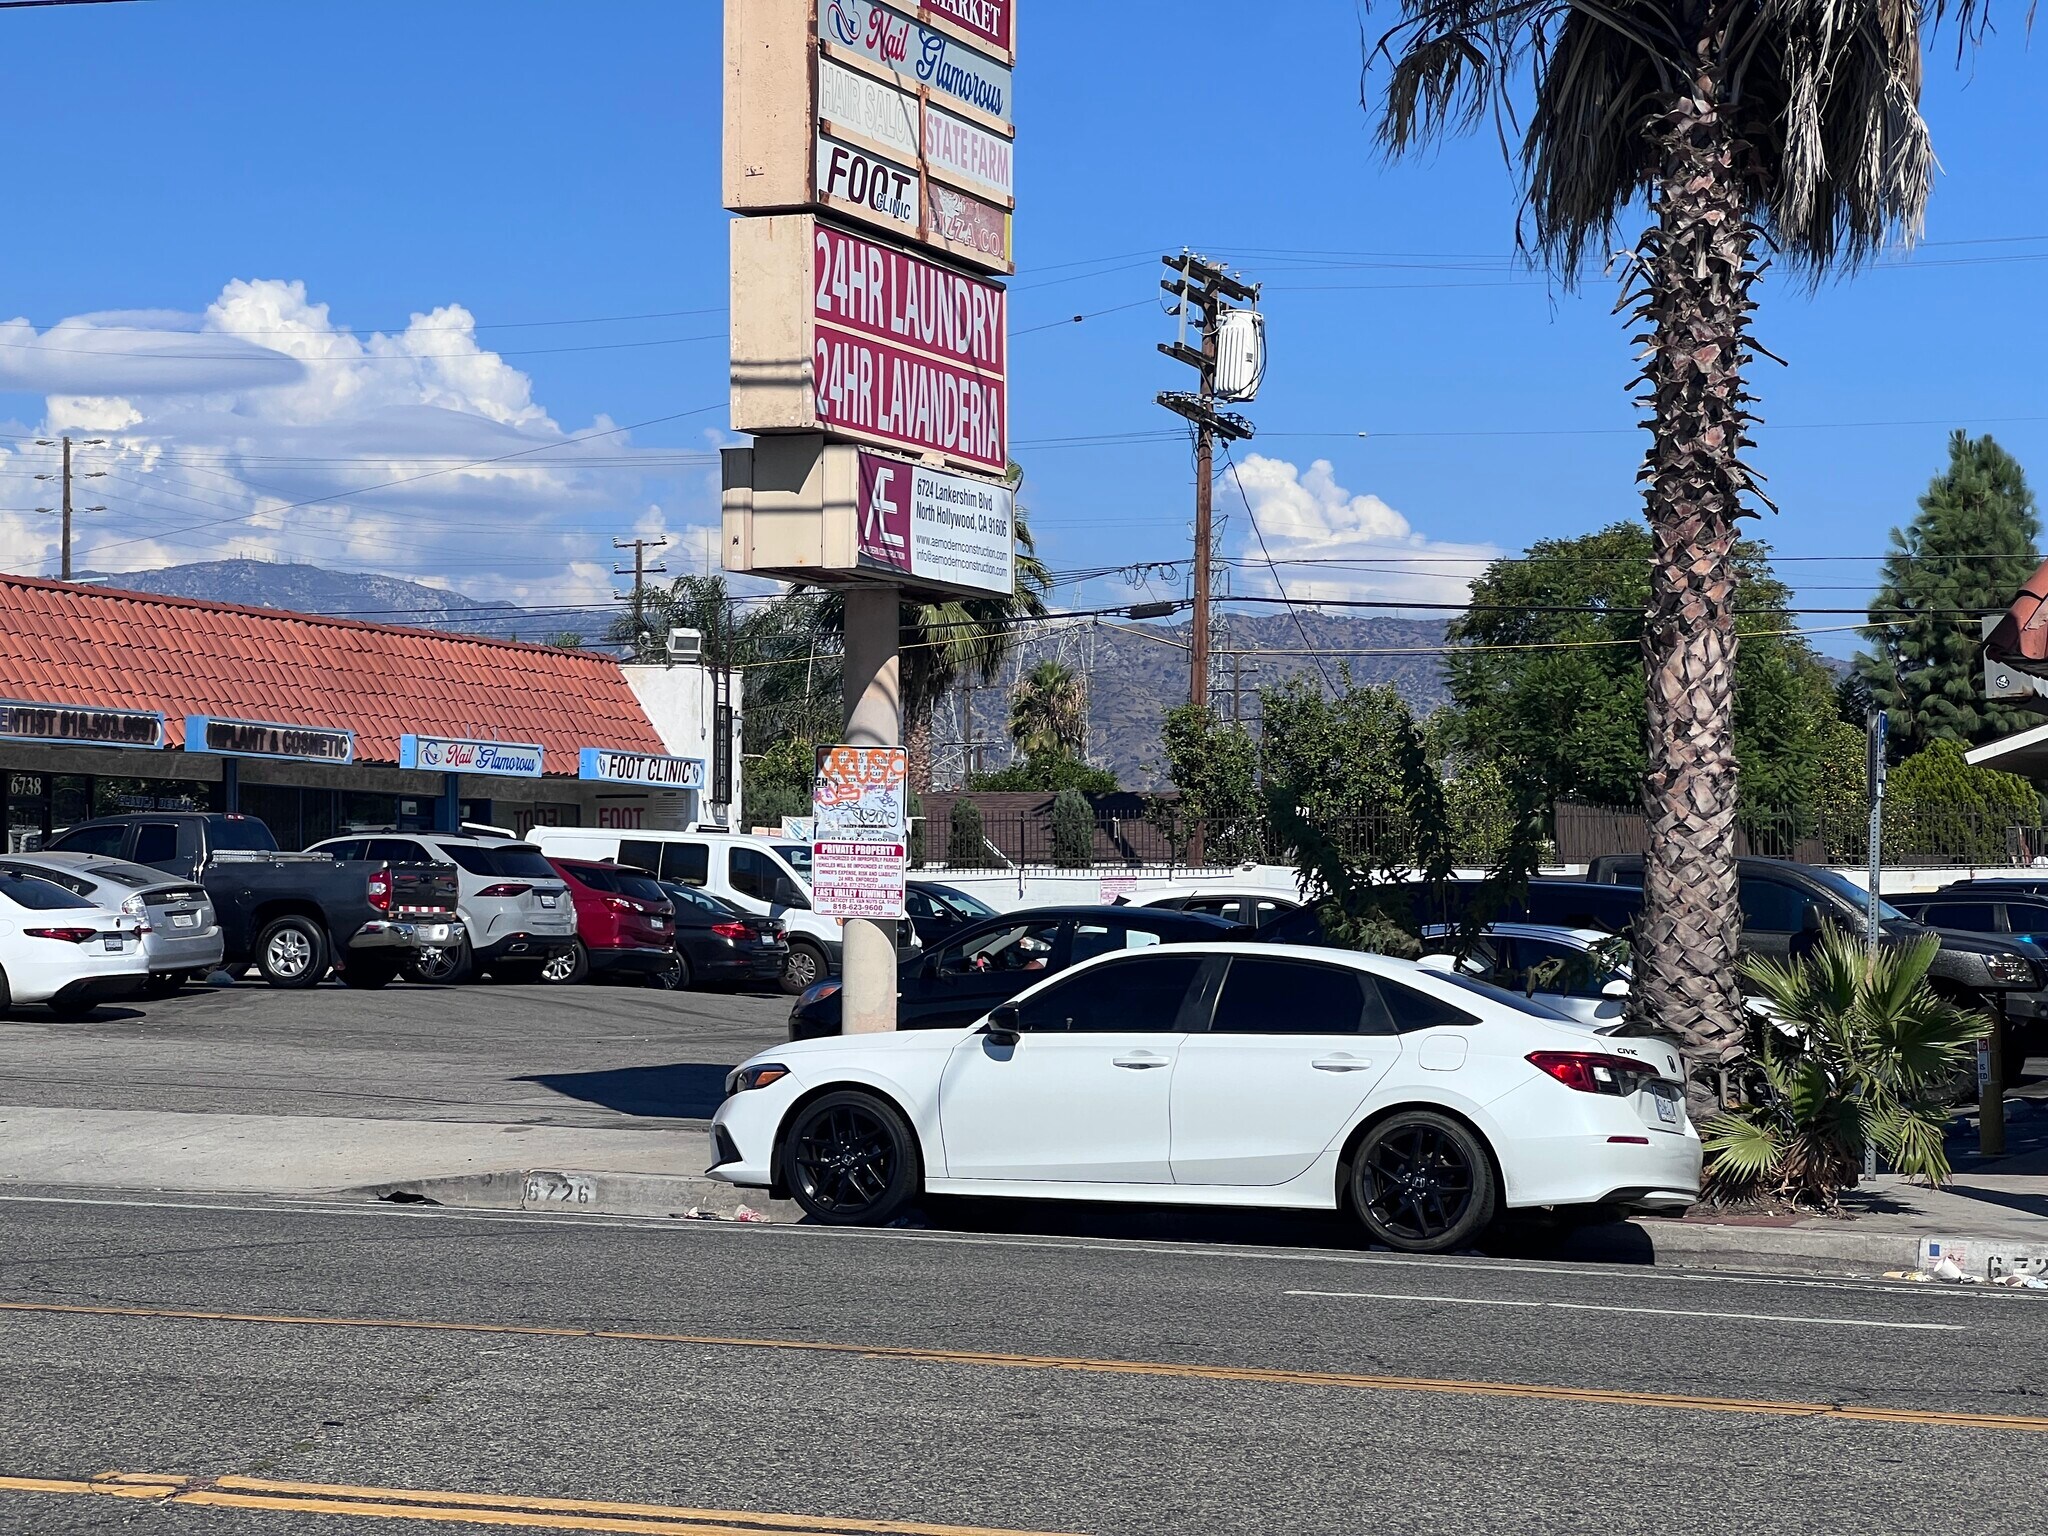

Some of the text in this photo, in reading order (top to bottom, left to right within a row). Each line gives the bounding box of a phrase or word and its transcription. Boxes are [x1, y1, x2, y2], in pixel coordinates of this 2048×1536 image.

[866, 7, 910, 62] Nail
[916, 27, 1003, 116] Glamorous
[822, 64, 917, 146] HAIR SALON
[926, 113, 1009, 187] STATE FARM
[827, 147, 911, 217] FOOT
[876, 193, 911, 220] CLINIC
[816, 231, 1000, 364] 24HR LAUNDRY
[816, 337, 1001, 461] 24HR LAVANDERIA
[917, 478, 993, 511] 6724 Lankershim Blvd
[916, 501, 1007, 537] North Hollywood, CA 91606
[916, 534, 1008, 562] www.aemodernconstruction.com
[916, 547, 1008, 577] info@aemodernconstruction.com
[269, 730, 279, 752] &
[282, 730, 348, 759] COSMETIC
[446, 744, 473, 767] Nail
[475, 744, 536, 772] Glamorous
[608, 755, 692, 784] FOOT CLINIC
[10, 775, 42, 796] 6738
[599, 807, 645, 830] FOOT
[821, 843, 896, 856] PRIVATE PROPERTY
[815, 887, 901, 899] EAST VALLEY TOWING INC.
[833, 903, 883, 911] 818-623-9600
[1617, 1047, 1638, 1056] CIVIC
[527, 1181, 590, 1204] 6726
